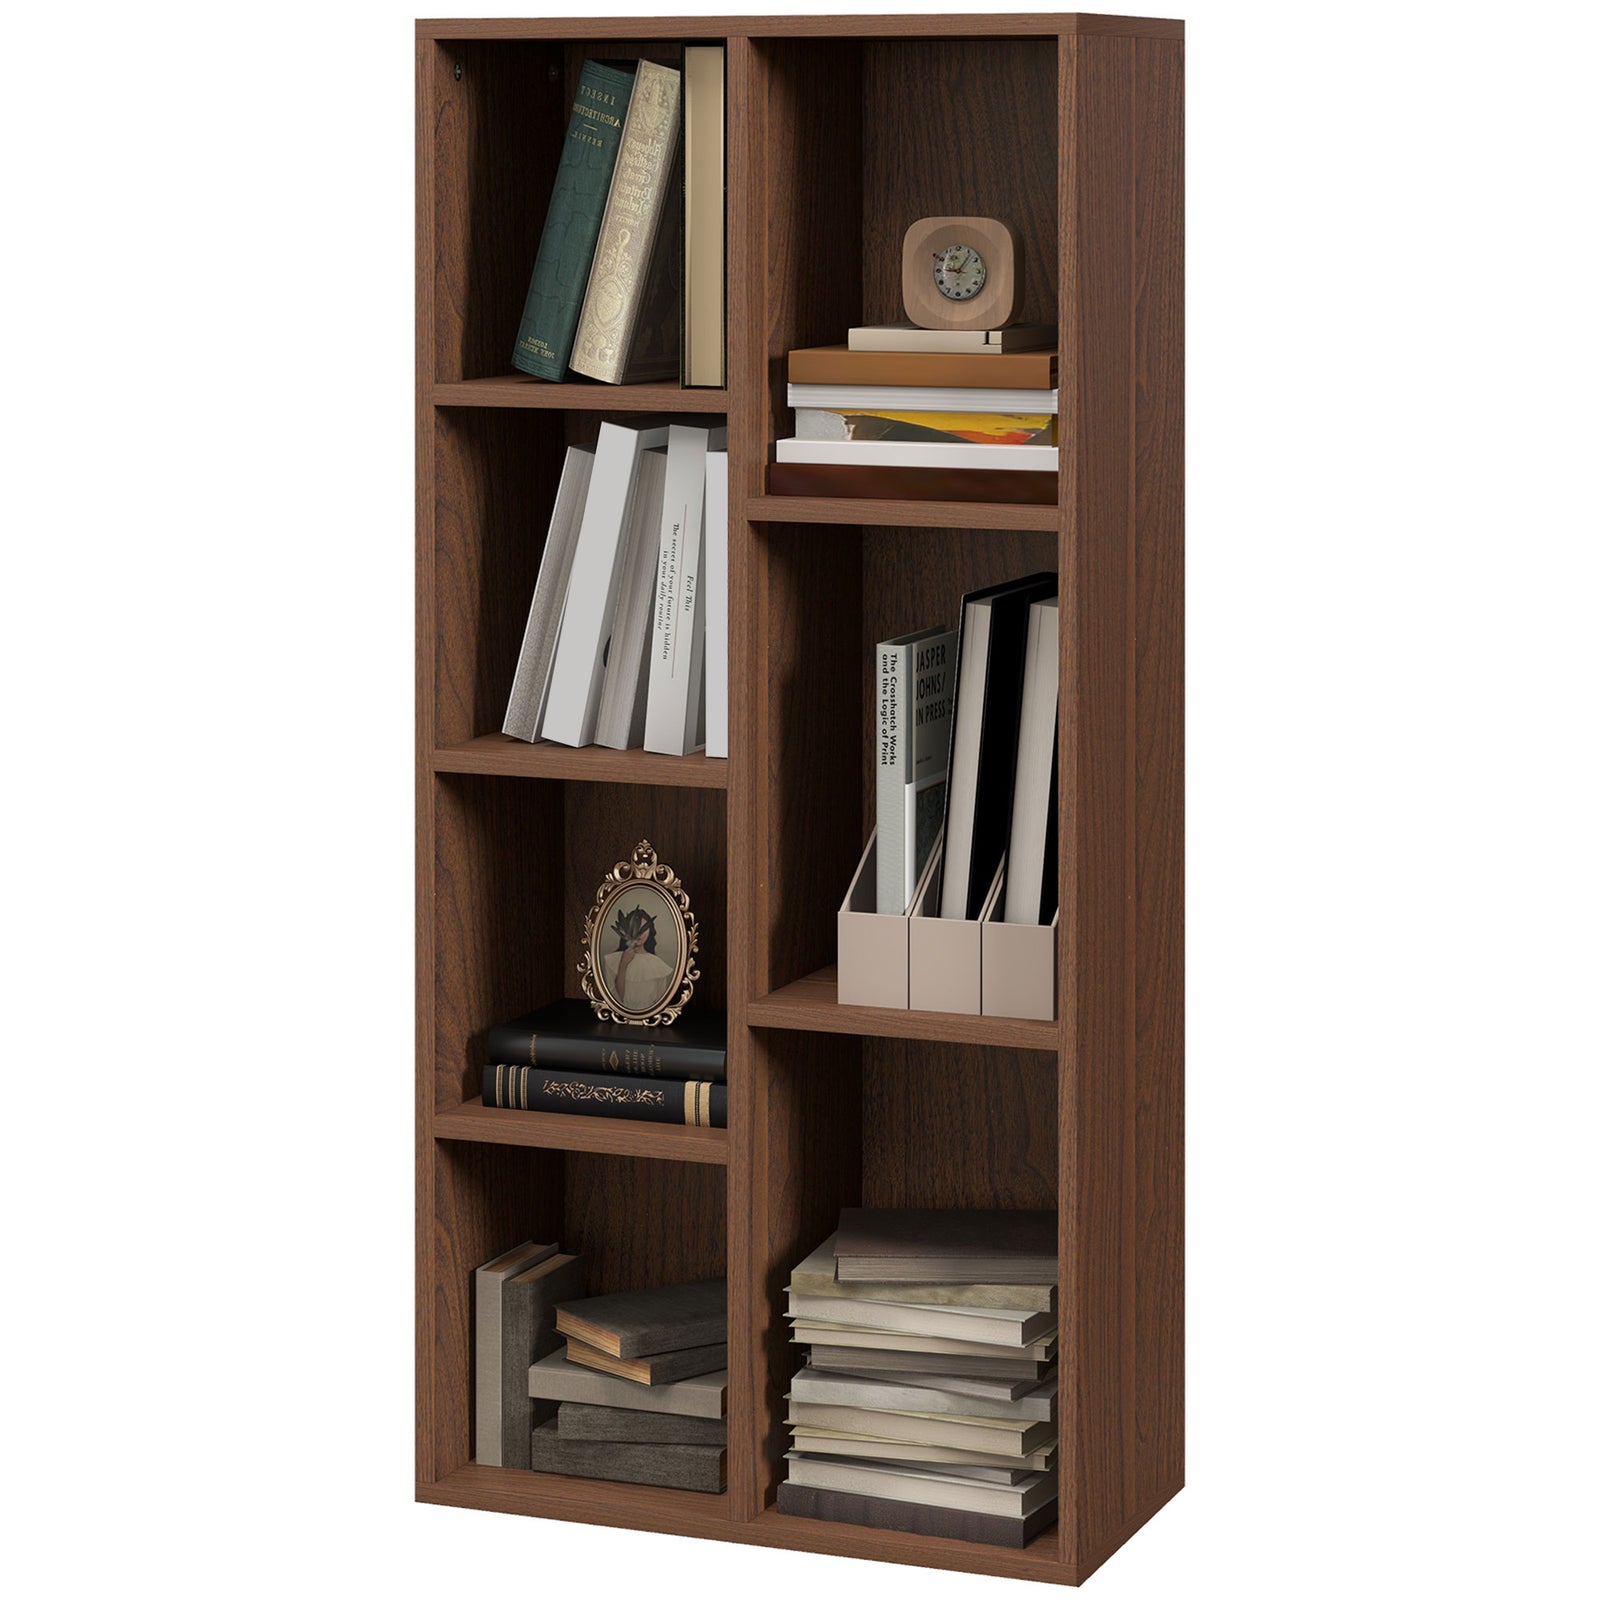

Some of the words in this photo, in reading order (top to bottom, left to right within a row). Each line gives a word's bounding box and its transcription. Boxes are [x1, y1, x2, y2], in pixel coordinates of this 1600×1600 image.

[663, 550, 669, 559] in
[670, 564, 676, 574] of
[658, 581, 667, 600] daily
[662, 632, 671, 660] hidden
[916, 644, 946, 673] JASPER
[880, 699, 888, 726] Logic
[916, 706, 924, 727] IN
[925, 700, 946, 723] PRESS
[882, 728, 888, 739] of
